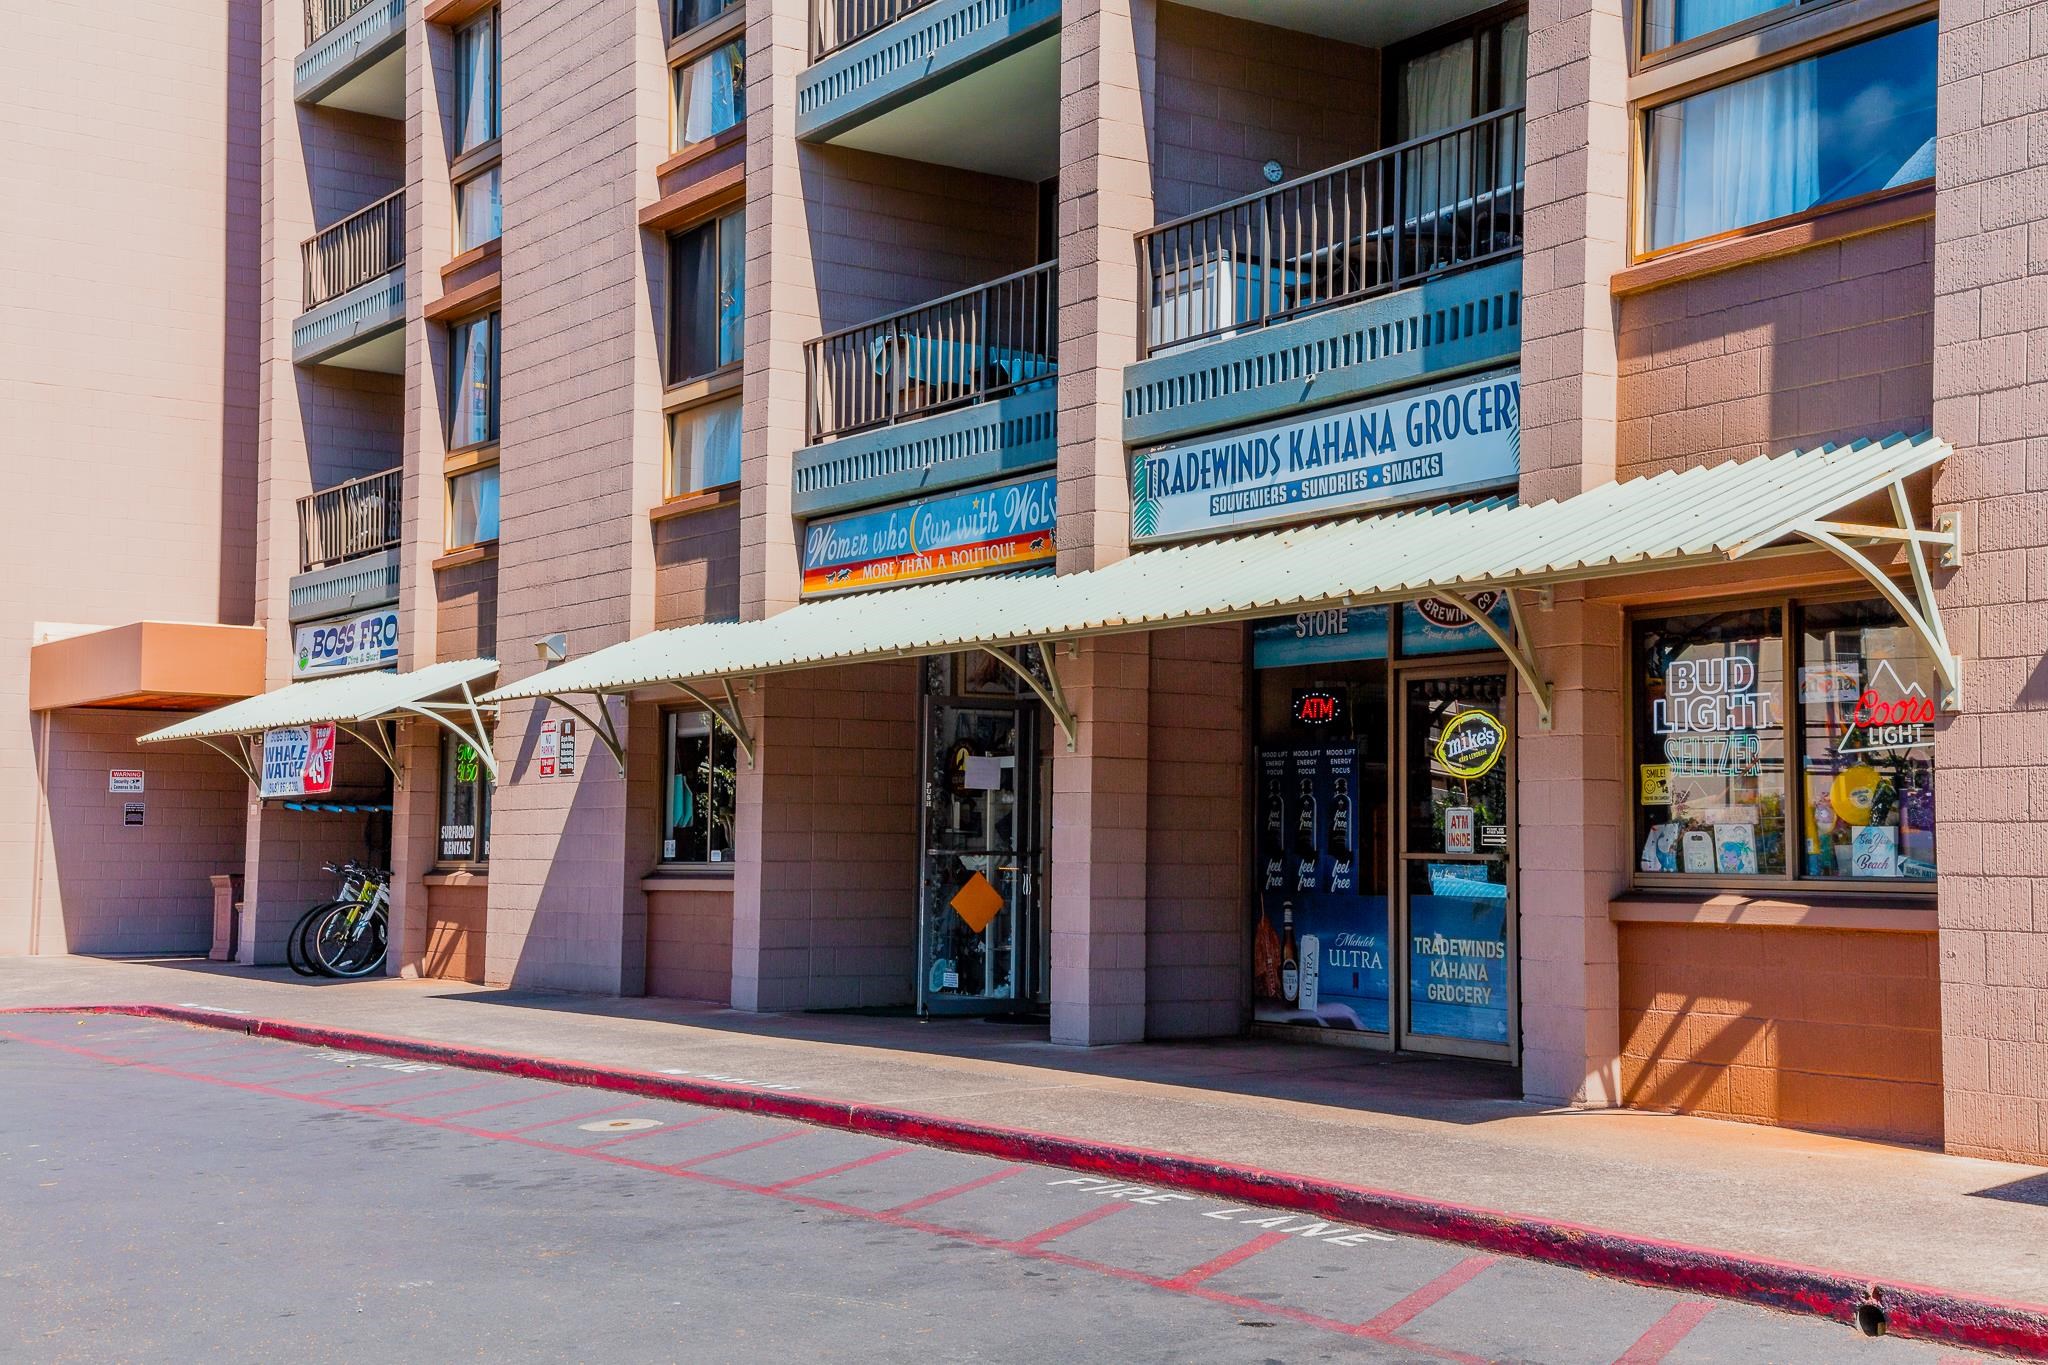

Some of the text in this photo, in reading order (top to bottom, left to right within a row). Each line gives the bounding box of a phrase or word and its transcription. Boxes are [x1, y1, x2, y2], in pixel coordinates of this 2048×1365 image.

[1145, 433, 1281, 499] TRADEWINDS
[1289, 408, 1397, 473] KAHANA
[1211, 454, 1441, 514] SOUVENIERS SUNDRIES SNACKS
[808, 524, 869, 568] Women
[872, 512, 907, 556] who
[918, 512, 951, 546] Run
[956, 491, 999, 539] with
[862, 541, 1017, 581] MORE THAN A BOUTIQUE
[1423, 598, 1469, 622] BREWIN
[1295, 607, 1349, 639] STORE
[311, 623, 357, 659] BOSS
[1668, 656, 1755, 697] BUD
[1302, 698, 1335, 720] ATM
[1854, 689, 1935, 728] Coors
[1445, 727, 1496, 758] mike's
[1869, 723, 1925, 745] LIGHT
[265, 744, 309, 763] WHALE
[1664, 734, 1763, 778] SELTZER
[265, 760, 304, 780] WATCH
[309, 751, 325, 784] 49
[1646, 768, 1667, 779] SMILE!
[441, 825, 475, 840] SURFBOARD
[1450, 815, 1469, 830] ATM
[443, 840, 471, 855] RENTALS
[1448, 832, 1471, 847] INSIDE
[1266, 858, 1283, 876] feel
[1298, 857, 1316, 877] feel
[1331, 858, 1350, 878] feel
[1856, 853, 1889, 870] Beach
[1265, 873, 1284, 891] free
[1297, 873, 1317, 892] free
[1331, 873, 1351, 893] free
[1334, 932, 1376, 948] Michelob
[1413, 936, 1505, 960] TRADEWINDS
[1328, 948, 1383, 970] ULTRA
[1305, 951, 1314, 997] ULTRA
[1429, 960, 1489, 982] KAHANA
[1427, 983, 1491, 1005] GROCERY
[1046, 1177, 1397, 1248] FIRE LANE
